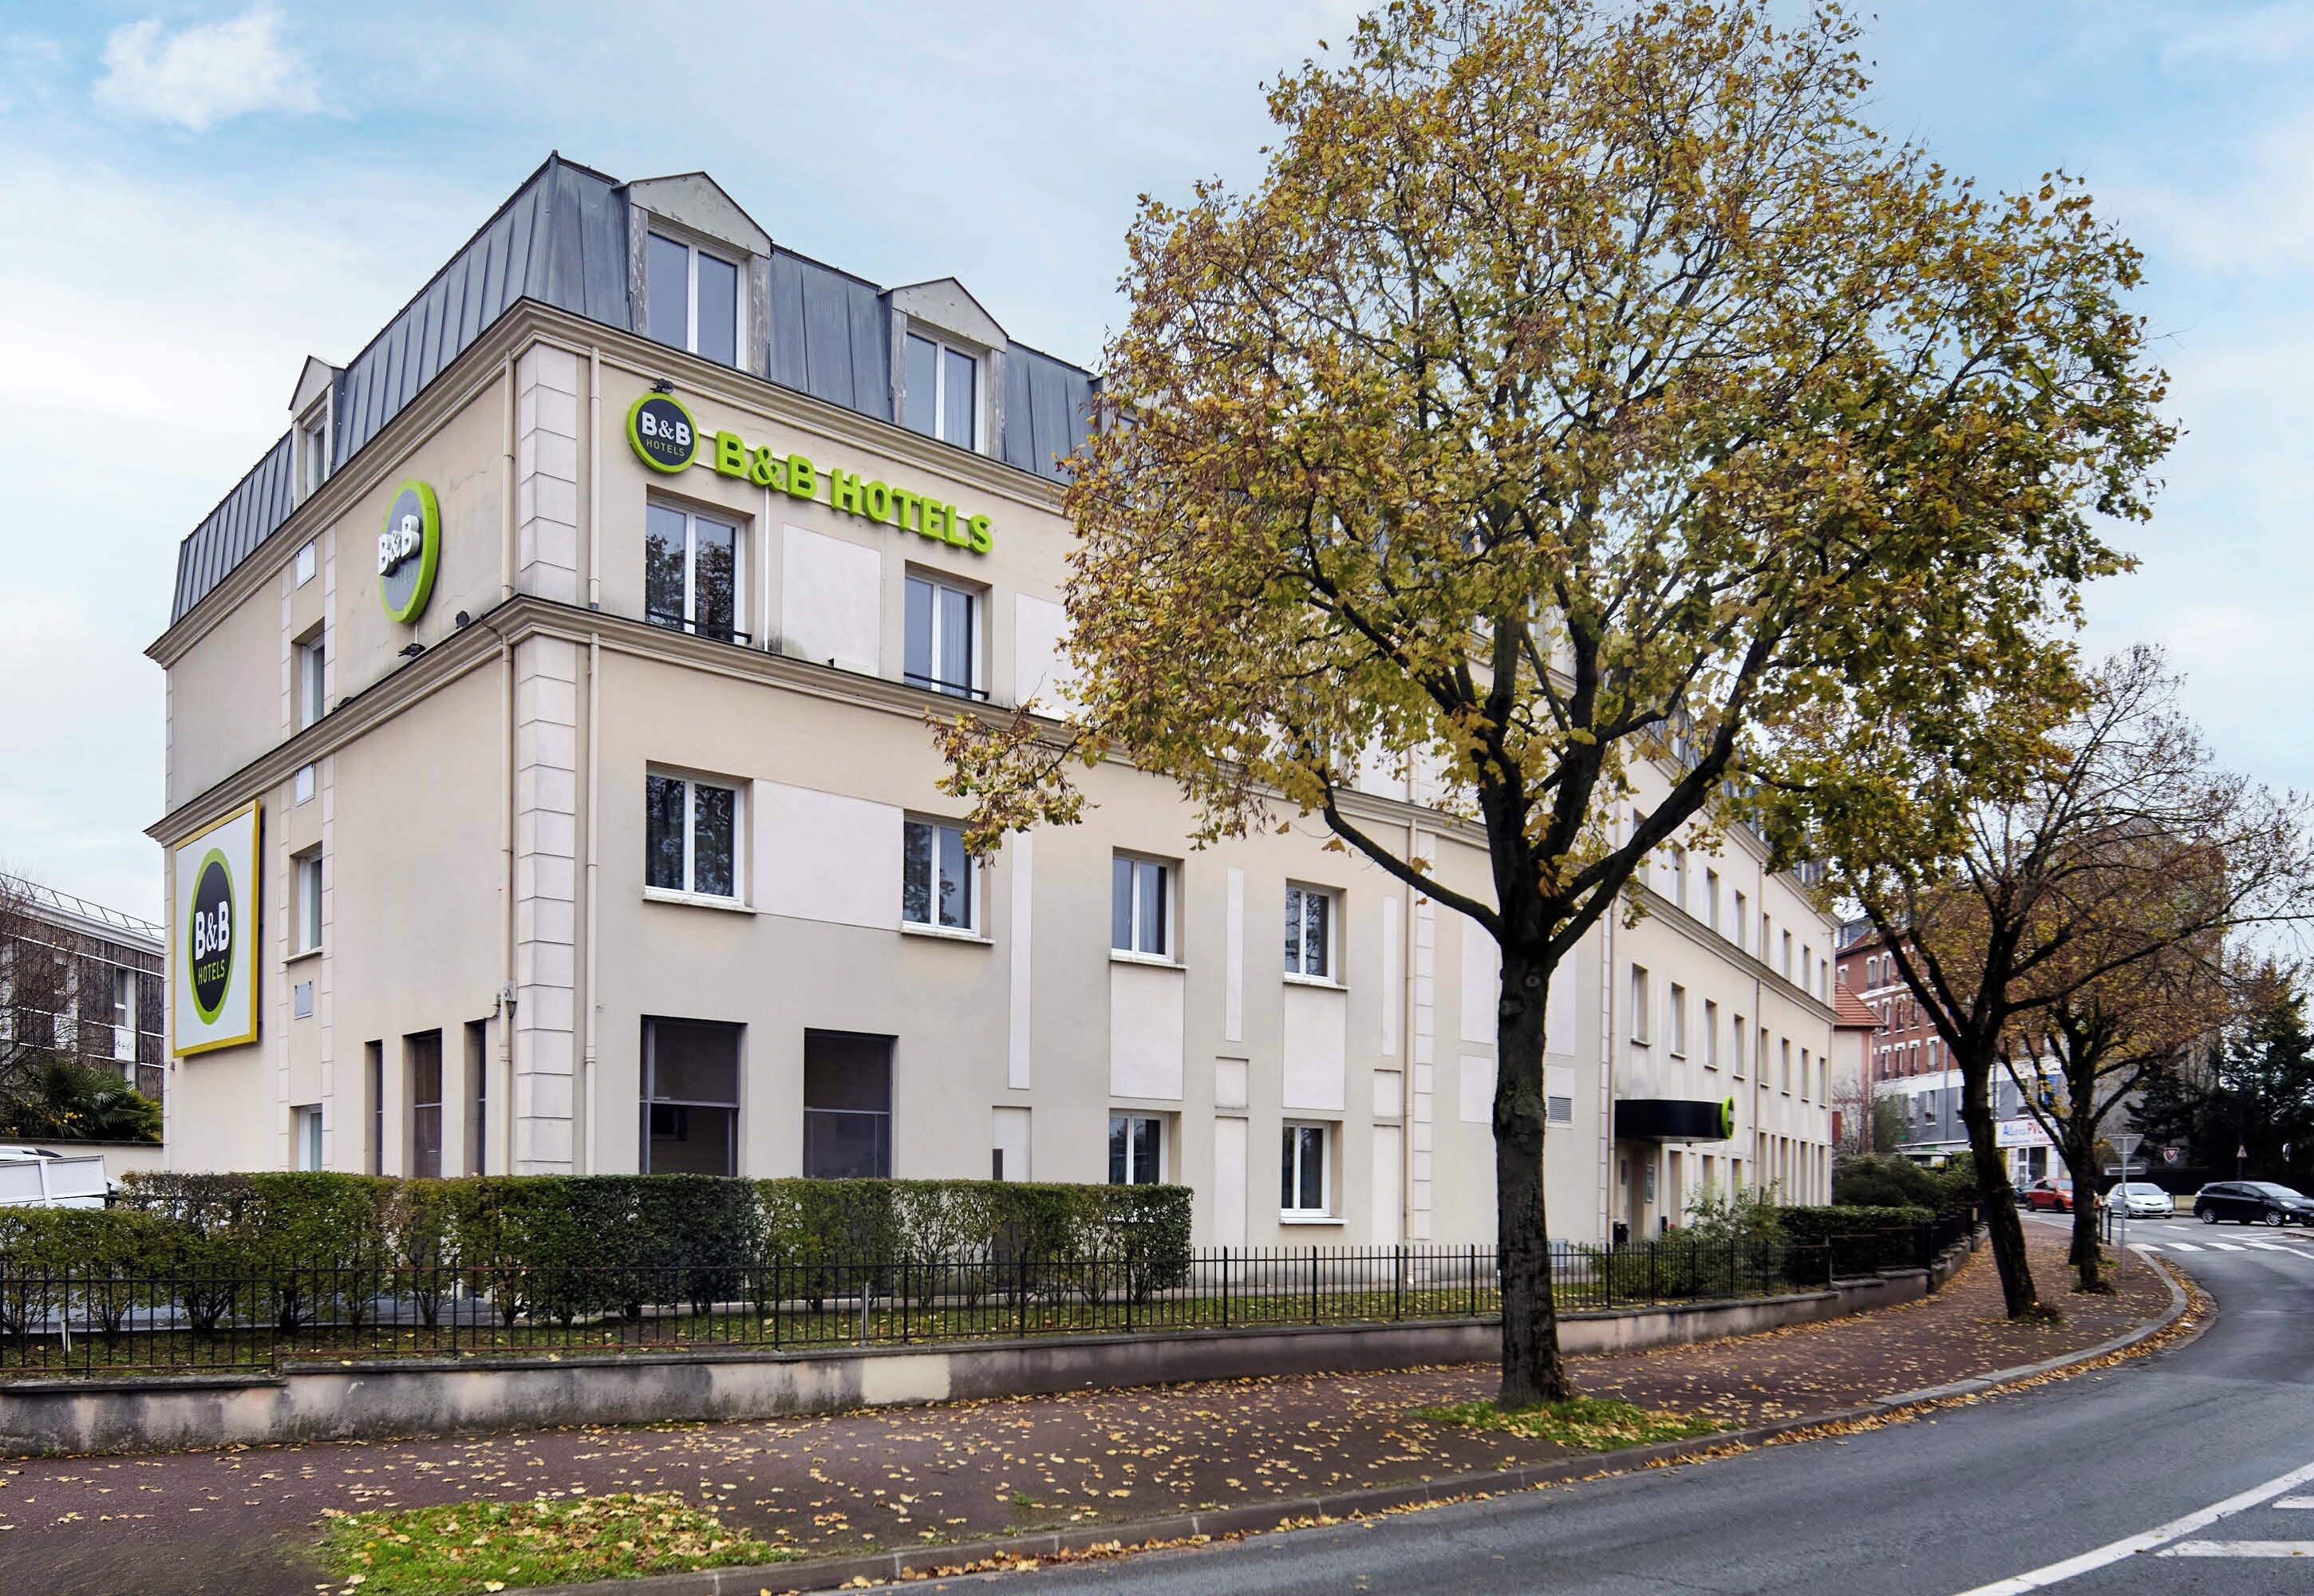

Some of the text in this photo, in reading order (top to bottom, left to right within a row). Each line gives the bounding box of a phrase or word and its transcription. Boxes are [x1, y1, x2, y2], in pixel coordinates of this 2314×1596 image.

[642, 411, 690, 445] B&B
[646, 438, 685, 456] HOTELS
[716, 430, 993, 554] B&B HOTELS
[378, 514, 420, 575] B&B
[195, 900, 229, 960] B&B
[198, 959, 225, 985] HOTELS
